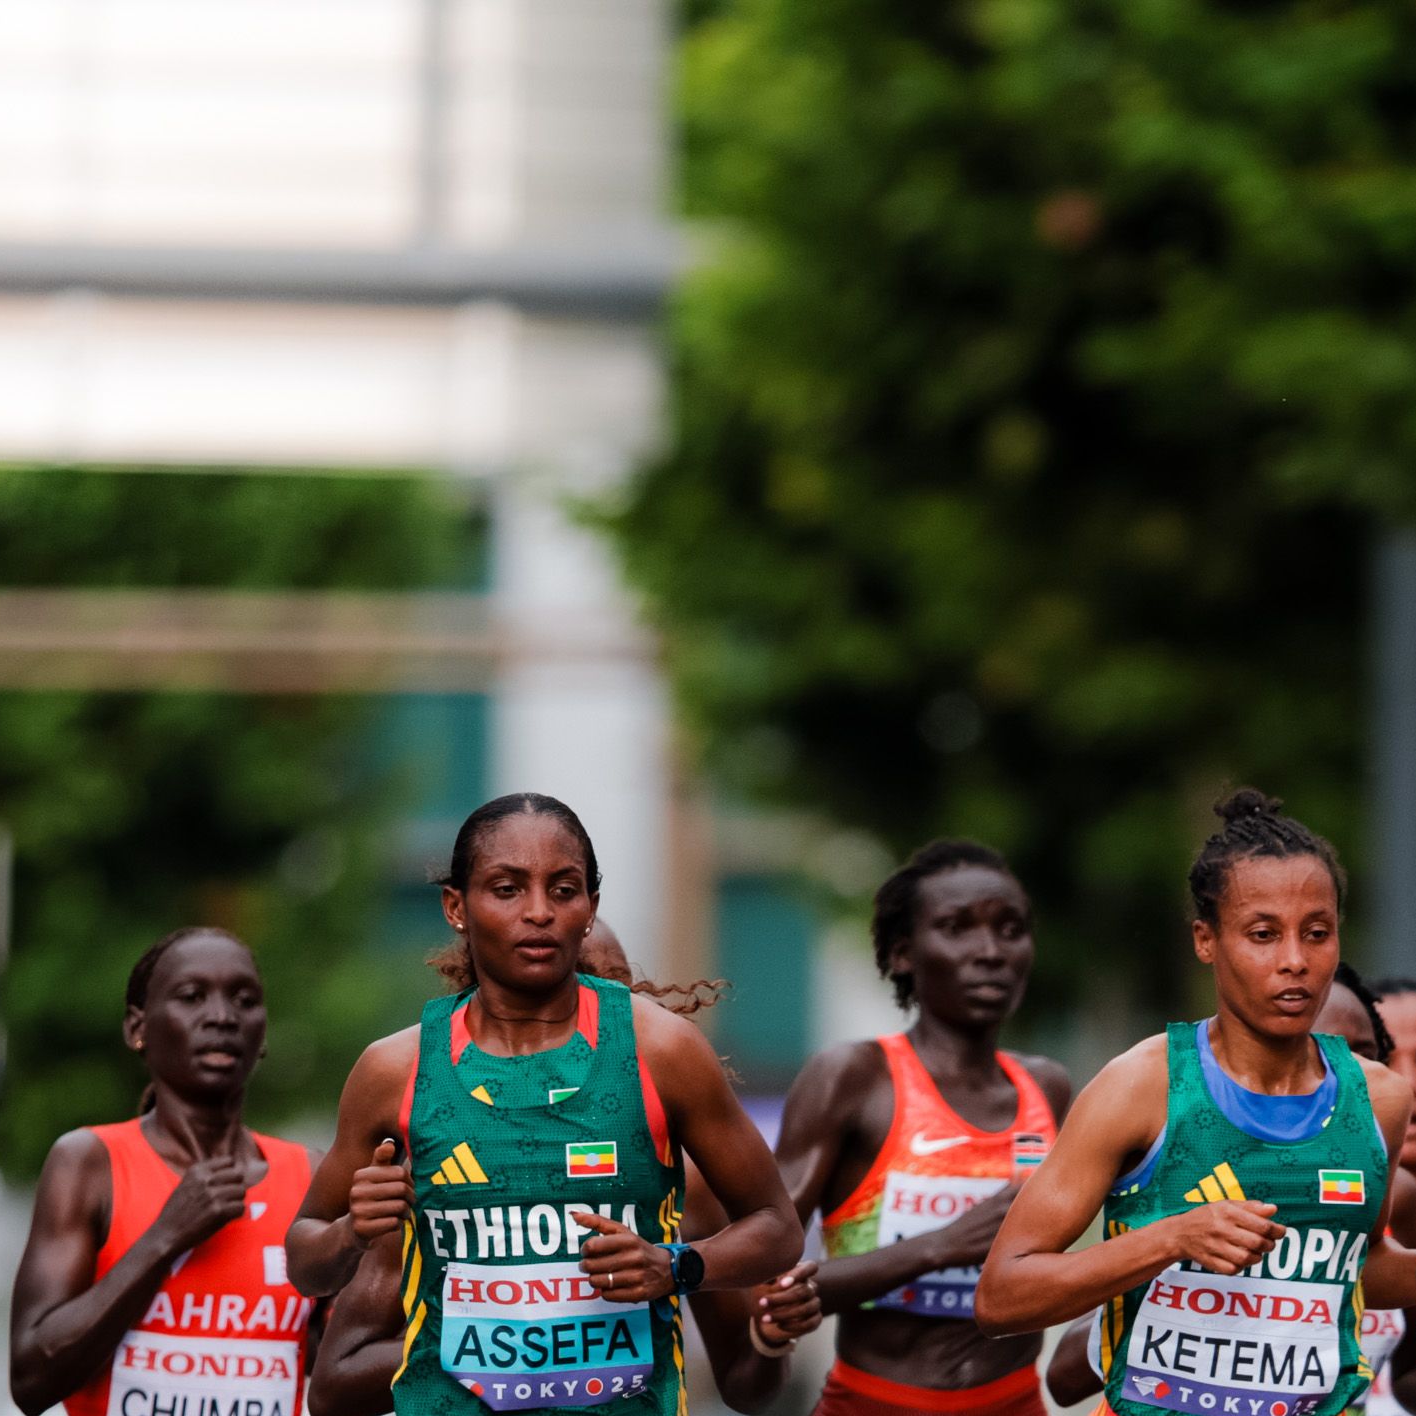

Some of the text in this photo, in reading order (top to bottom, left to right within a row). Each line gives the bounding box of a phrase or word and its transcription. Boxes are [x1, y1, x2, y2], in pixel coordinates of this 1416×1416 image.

[446, 1277, 603, 1305] HOND
[1146, 1279, 1334, 1325] HONDA
[121, 1346, 292, 1380] HONDA
[452, 1318, 640, 1369] ASSEFA
[1140, 1324, 1326, 1388] KETEMA
